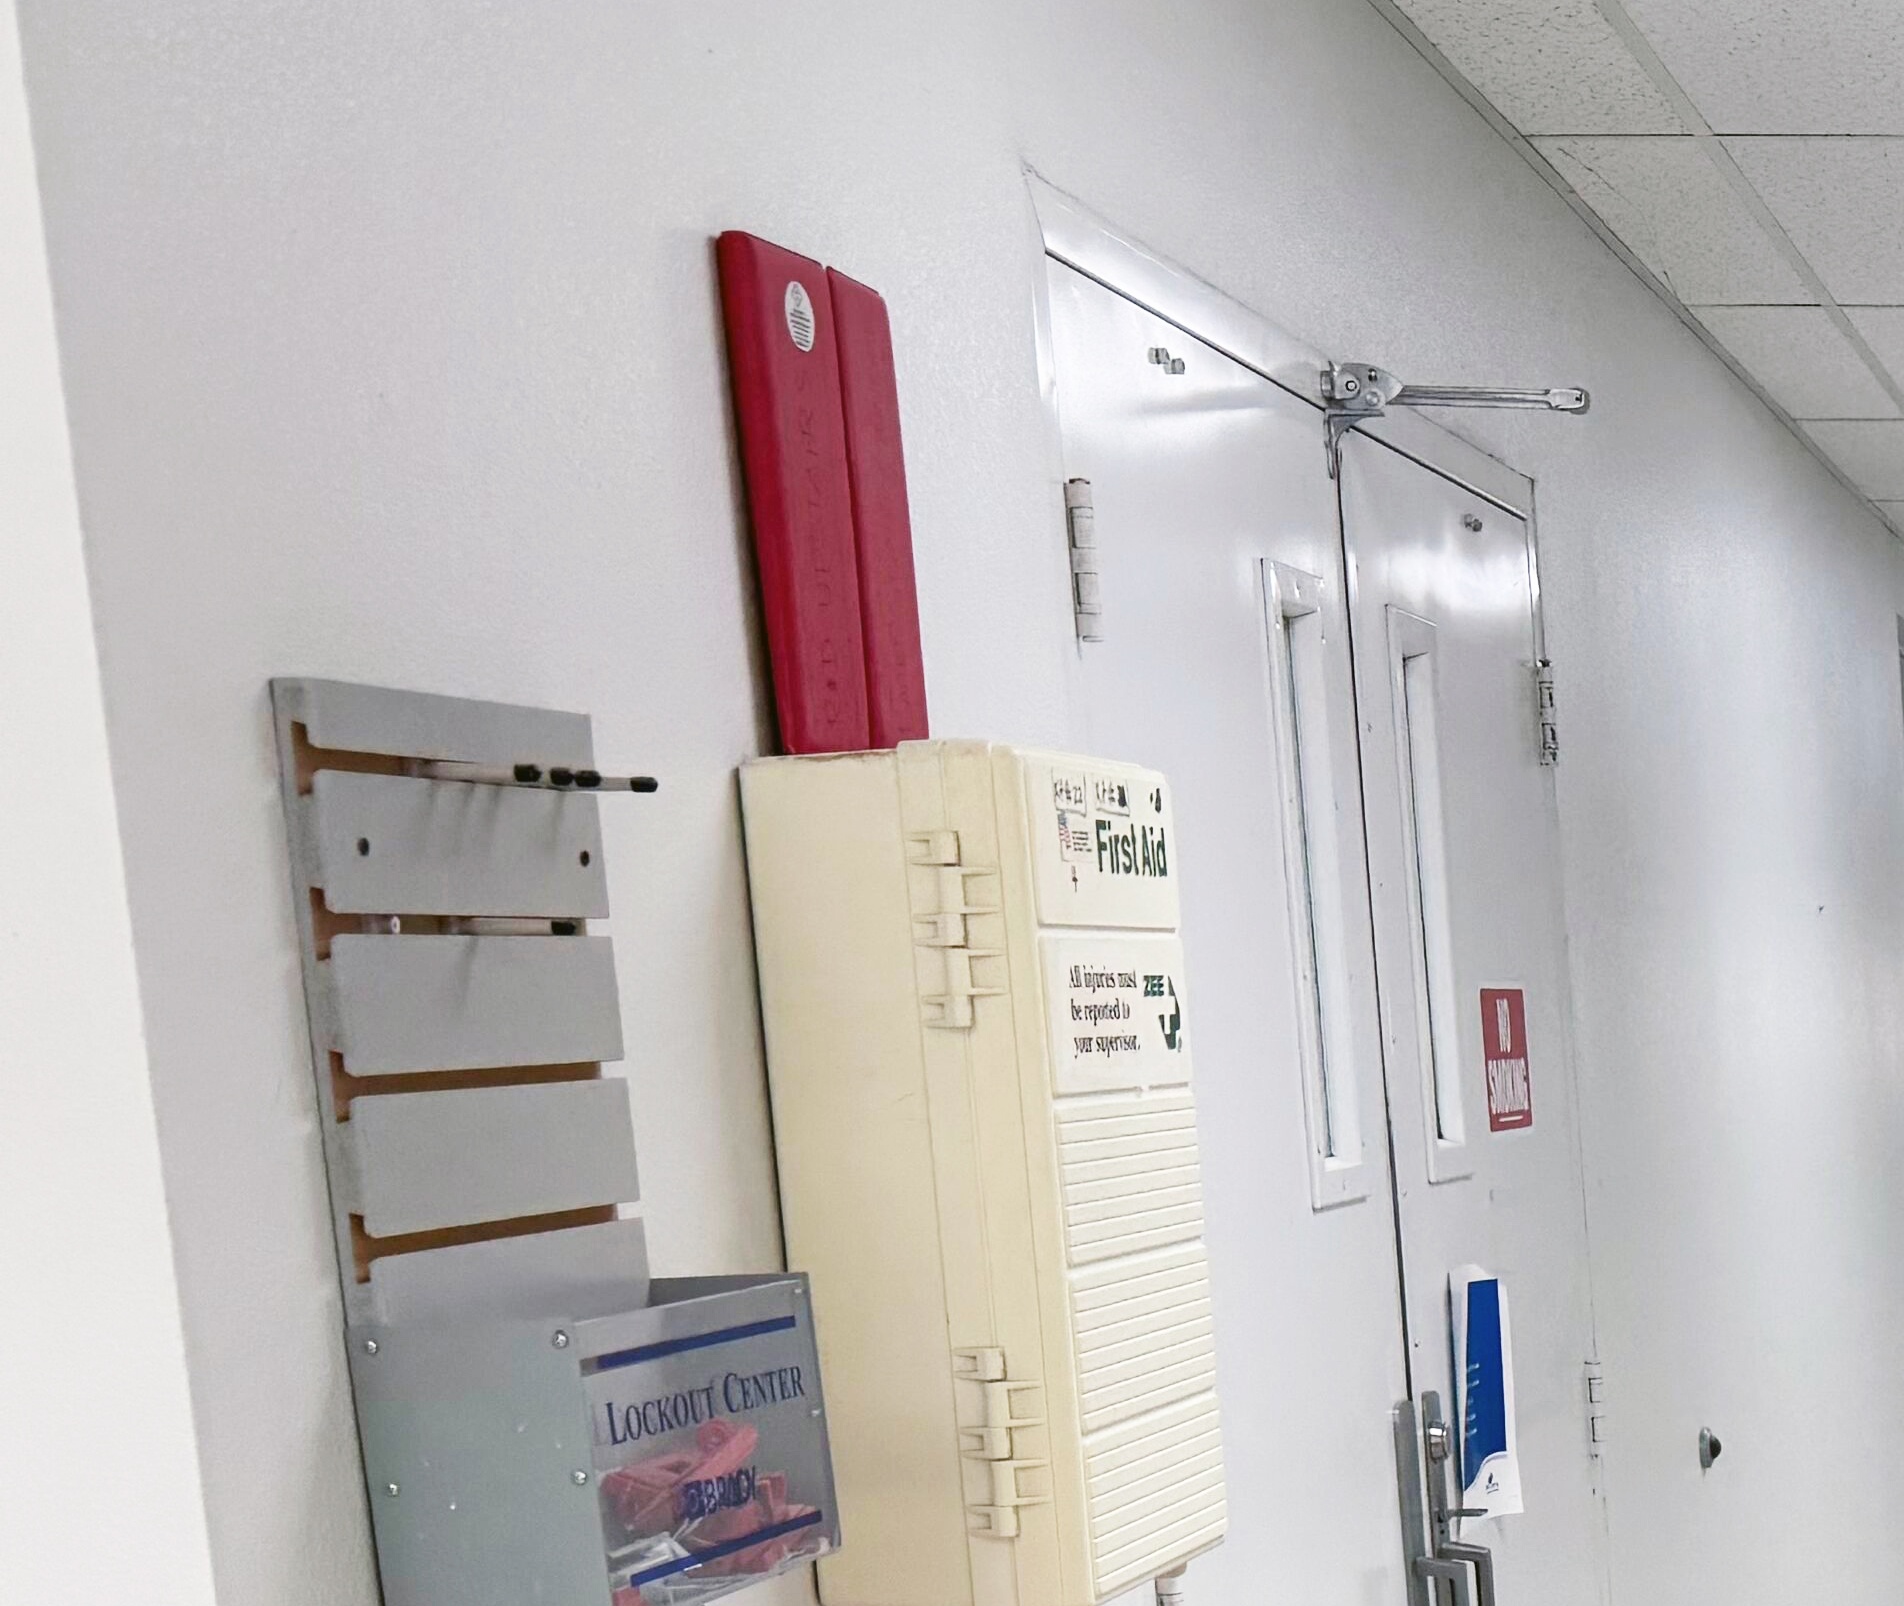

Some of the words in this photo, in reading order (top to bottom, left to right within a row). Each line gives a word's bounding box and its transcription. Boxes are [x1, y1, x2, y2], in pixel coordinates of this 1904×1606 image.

[1095, 819, 1139, 876] First
[1141, 825, 1168, 877] Aid
[1069, 965, 1082, 988] All
[1083, 964, 1116, 994] injuries
[1118, 969, 1137, 988] must
[1143, 975, 1165, 997] ZEE
[1070, 997, 1082, 1020] be
[1084, 997, 1121, 1026] reported
[1121, 1001, 1130, 1019] to
[1074, 1036, 1094, 1059] your
[1095, 1029, 1141, 1058] supervisor.
[606, 1385, 716, 1446] LOCKOUT
[723, 1365, 806, 1414] CENTER
